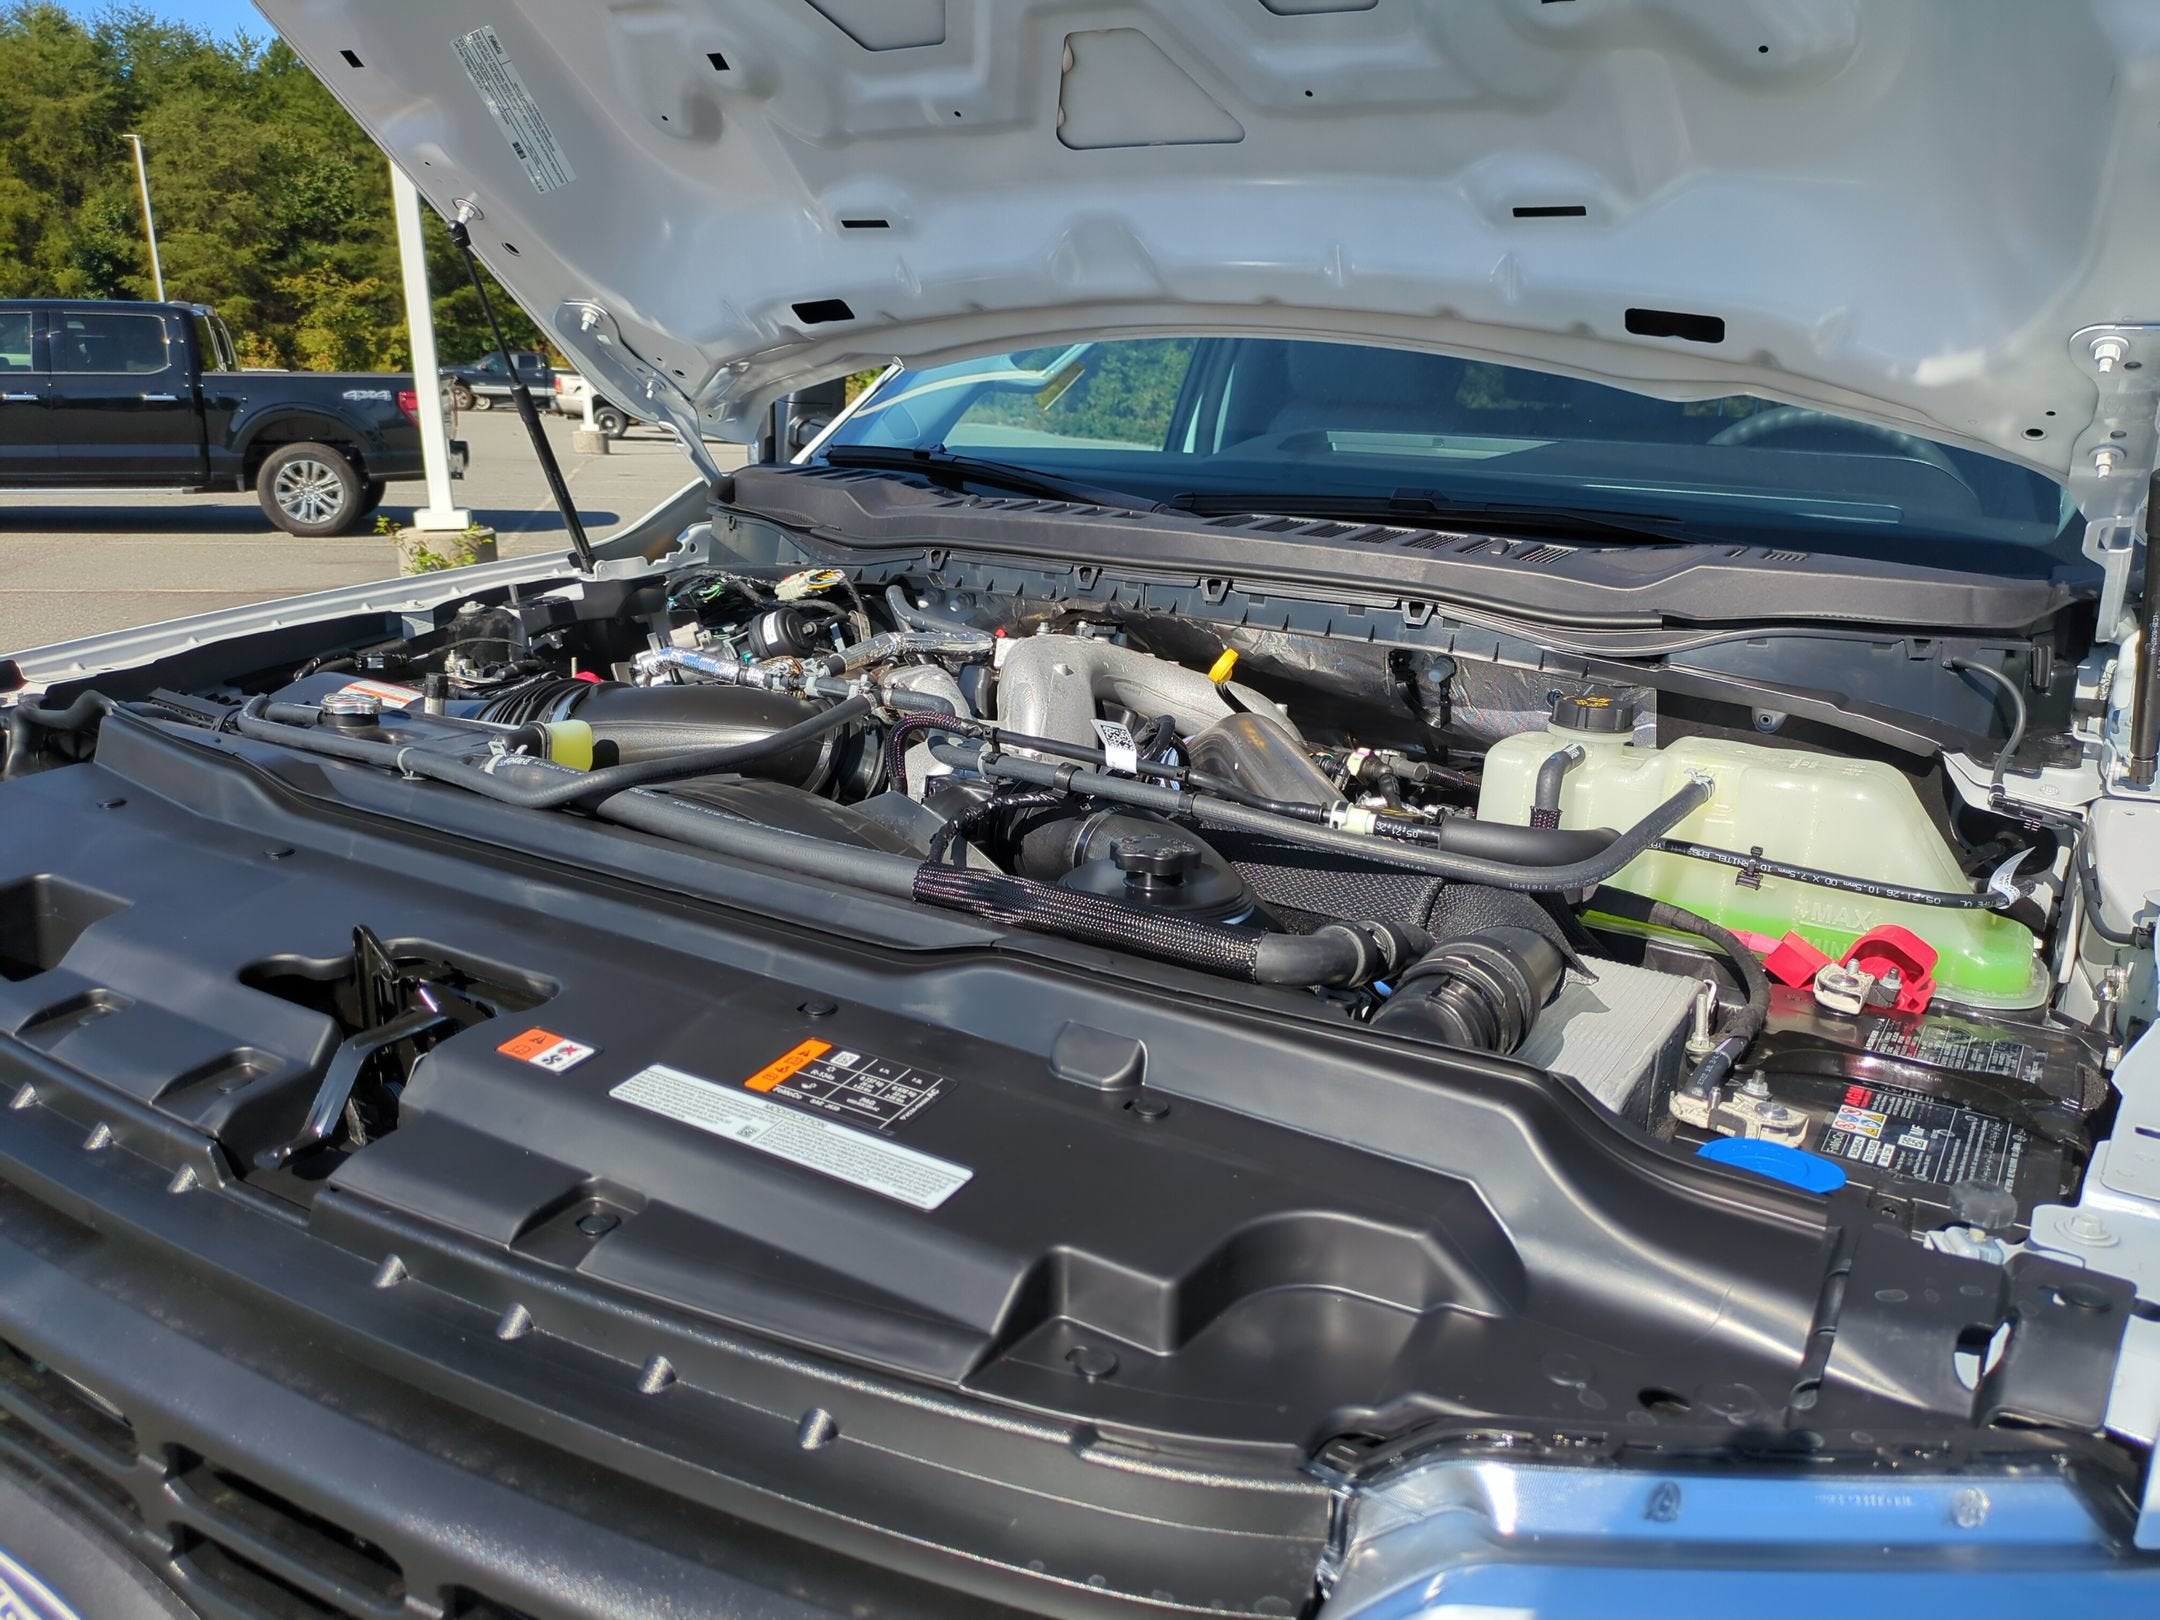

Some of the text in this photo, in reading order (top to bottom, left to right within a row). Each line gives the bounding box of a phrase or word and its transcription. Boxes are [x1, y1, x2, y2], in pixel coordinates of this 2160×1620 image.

[1777, 867, 1809, 881] 7.5mm
[1842, 878, 1881, 895] 10.5mm
[1810, 902, 1873, 932] MAX
